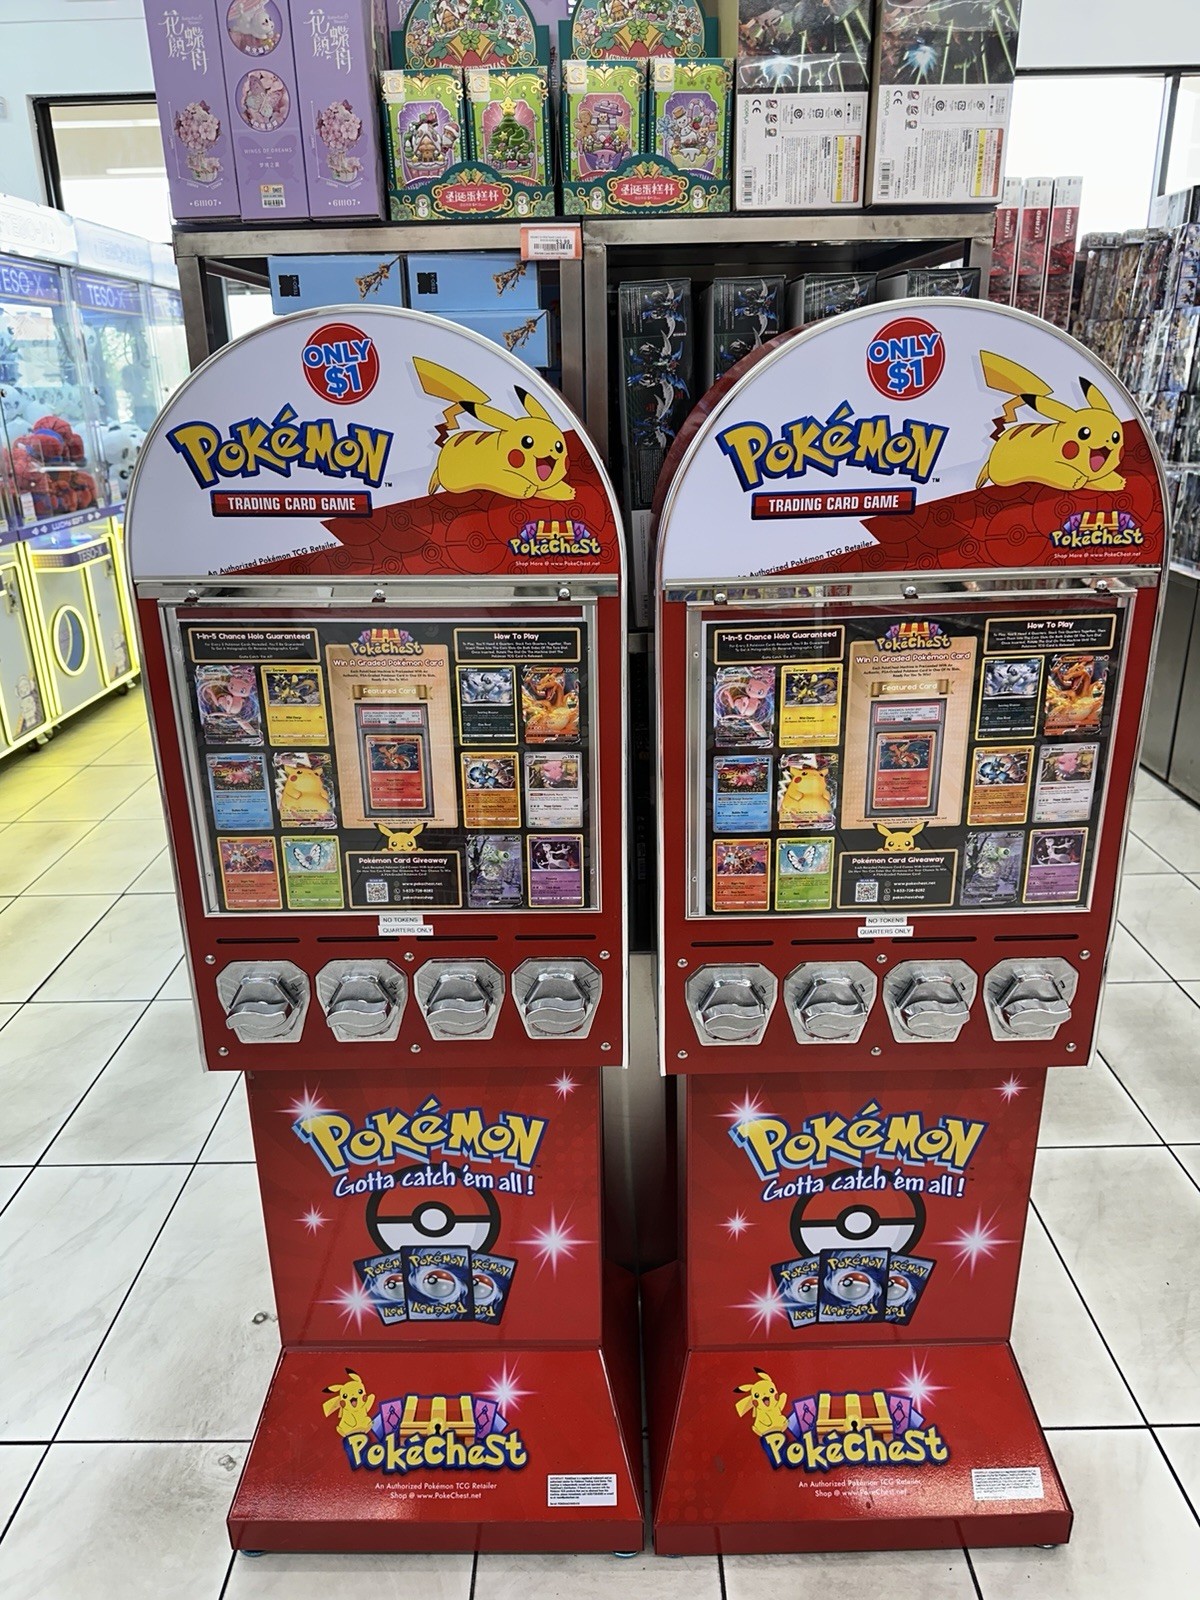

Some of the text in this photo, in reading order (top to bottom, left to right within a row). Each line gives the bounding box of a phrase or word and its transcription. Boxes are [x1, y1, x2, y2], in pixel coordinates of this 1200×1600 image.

[0, 268, 44, 296] ESO-X
[303, 338, 372, 398] ONLY $1
[867, 332, 941, 393] ONLY $1
[228, 498, 356, 511] TRADING CARD GAME
[769, 494, 899, 512] TRADING CARD GAME
[220, 561, 257, 574] Authorized
[259, 553, 290, 565] Pokémon
[292, 547, 308, 557] TCG
[310, 541, 337, 553] Retailer
[750, 541, 873, 577] Authorized Pokémon TCG Retailer
[1058, 621, 1074, 629] Play
[524, 633, 539, 641] Play
[773, 632, 790, 640] Holo
[792, 631, 837, 639] Guaranteed
[388, 658, 423, 667] Pokémon
[424, 659, 444, 667] Card
[881, 655, 911, 663] Graded
[912, 652, 949, 661] Pokémon
[950, 652, 971, 660] Card
[412, 857, 448, 865] Giveaway
[908, 856, 945, 864] Giveaway
[335, 1170, 395, 1198] Gotta
[401, 1161, 455, 1188] catch
[462, 1165, 493, 1189] 'em
[762, 1174, 824, 1201] Gotta
[831, 1165, 886, 1191] catch
[894, 1168, 923, 1192] 'em
[390, 1492, 407, 1500] Shop
[815, 1490, 832, 1498] Shop
